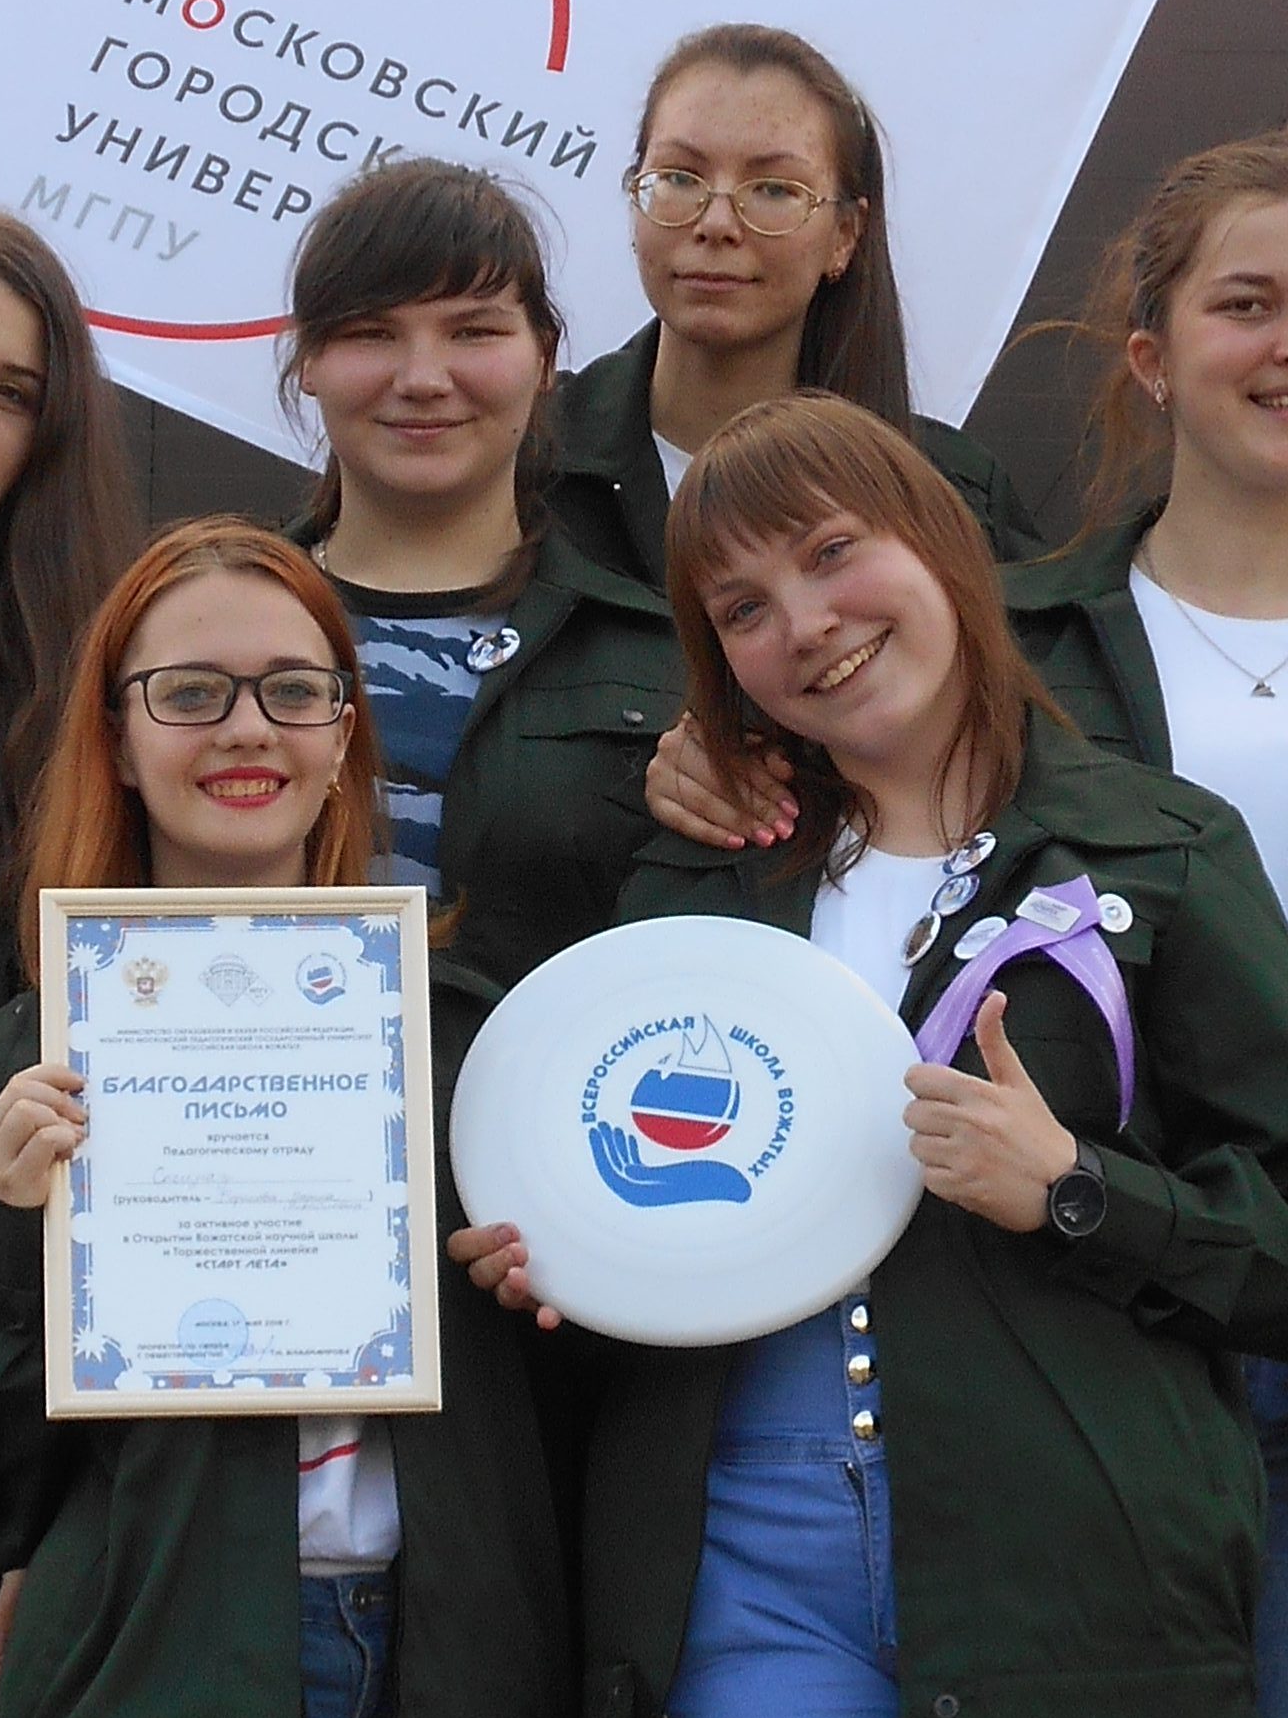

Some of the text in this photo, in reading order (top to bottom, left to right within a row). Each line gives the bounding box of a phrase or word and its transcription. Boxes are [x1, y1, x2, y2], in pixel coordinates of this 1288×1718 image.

[90, 35, 406, 173] ГОРОДСК
[55, 103, 314, 223] УНИВЕР
[23, 174, 201, 263] МГПУ
[102, 1072, 369, 1094] БЛАГОДАРСТВЕННОЕ
[581, 1015, 794, 1178] ВСЕРОССИЙСКАЯ ШКОЛА ВОЖАТЫХ
[184, 1101, 288, 1120] ПИСЬМО
[206, 1133, 270, 1144] вручается
[163, 1145, 315, 1157] Педагогическому отряду
[194, 1219, 250, 1229] активное
[253, 1218, 303, 1229] участие
